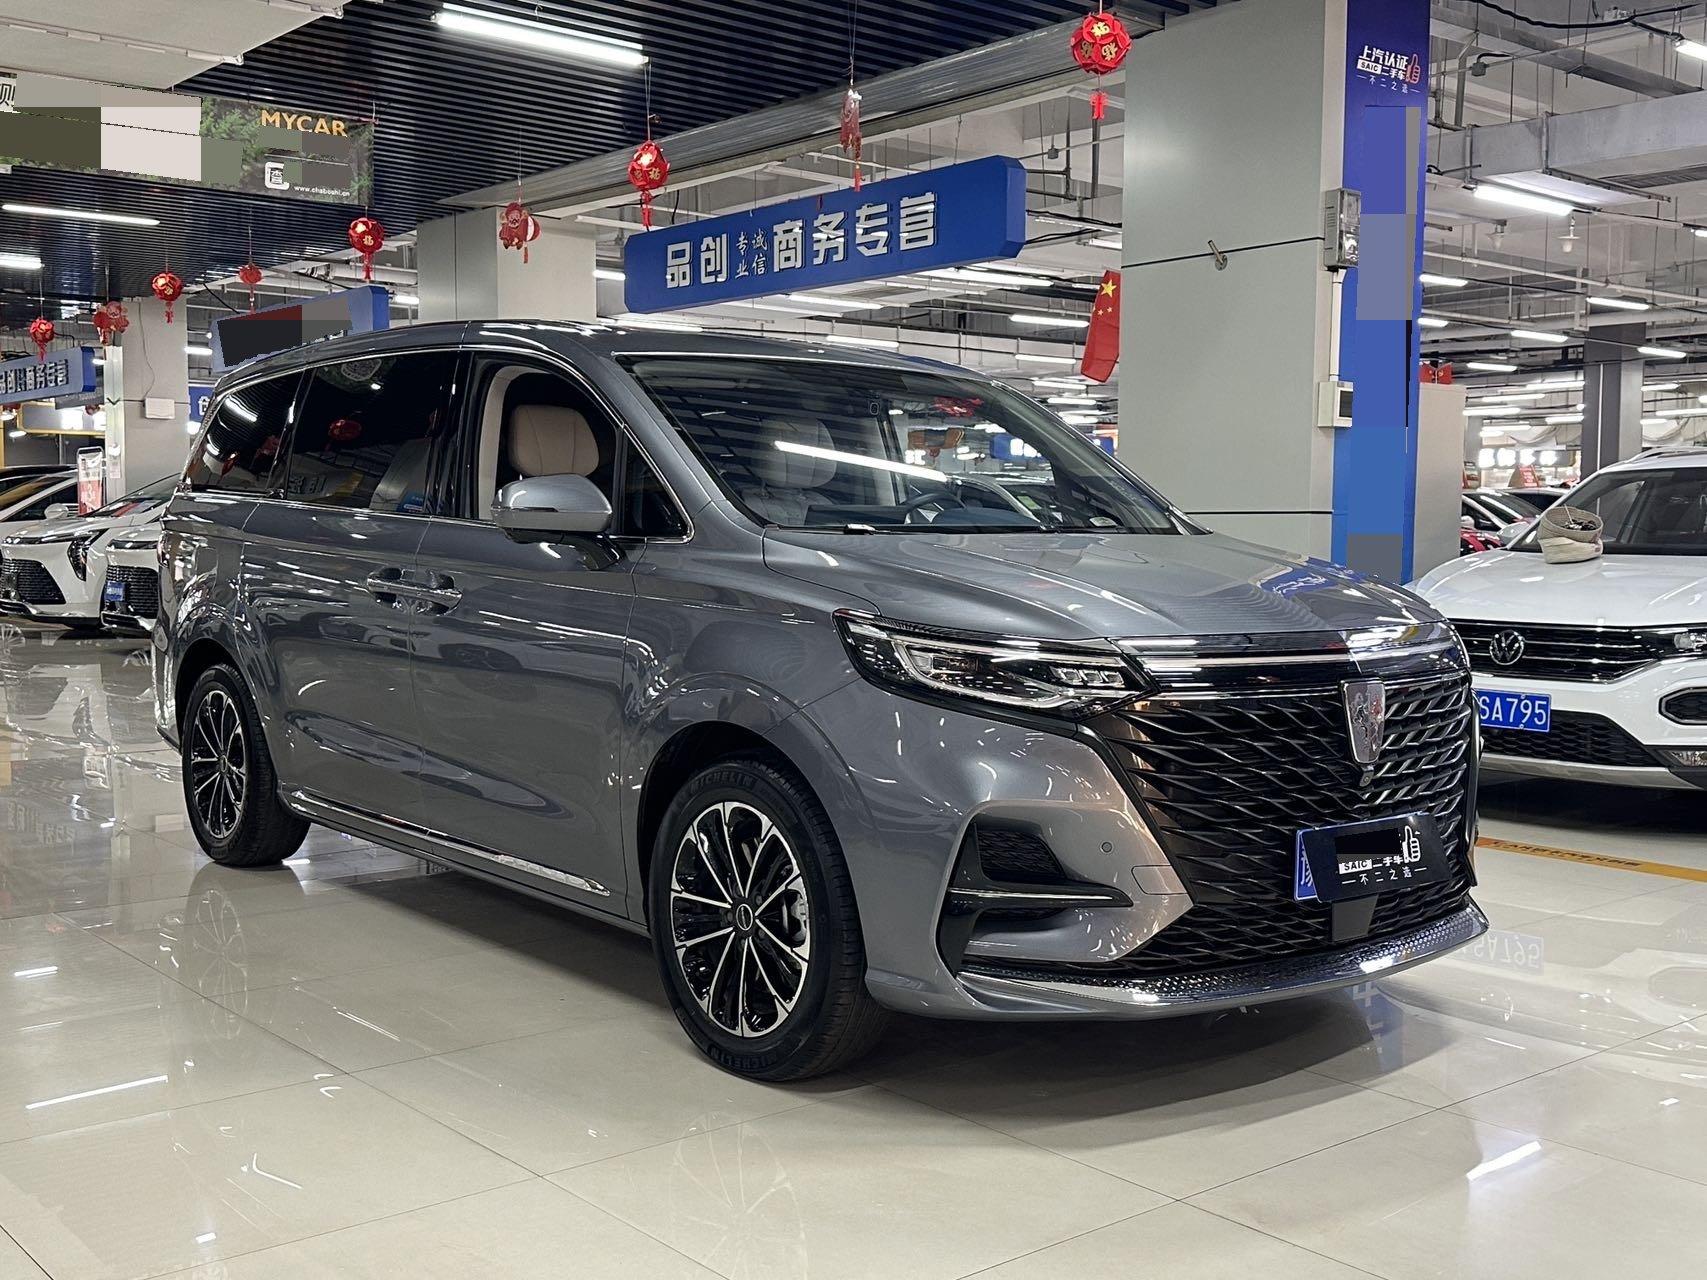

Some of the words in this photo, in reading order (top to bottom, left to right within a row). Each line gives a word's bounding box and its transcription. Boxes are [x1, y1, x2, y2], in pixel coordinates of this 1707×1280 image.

[1359, 45, 1409, 70] 上汽认证
[1361, 61, 1379, 72] SAIC
[1381, 66, 1406, 80] 二手车
[261, 110, 348, 138] MYCAR
[772, 191, 937, 273] 商务专营
[666, 233, 729, 289] 品创
[1479, 695, 1547, 725] SA795
[1343, 859, 1370, 871] SAIC
